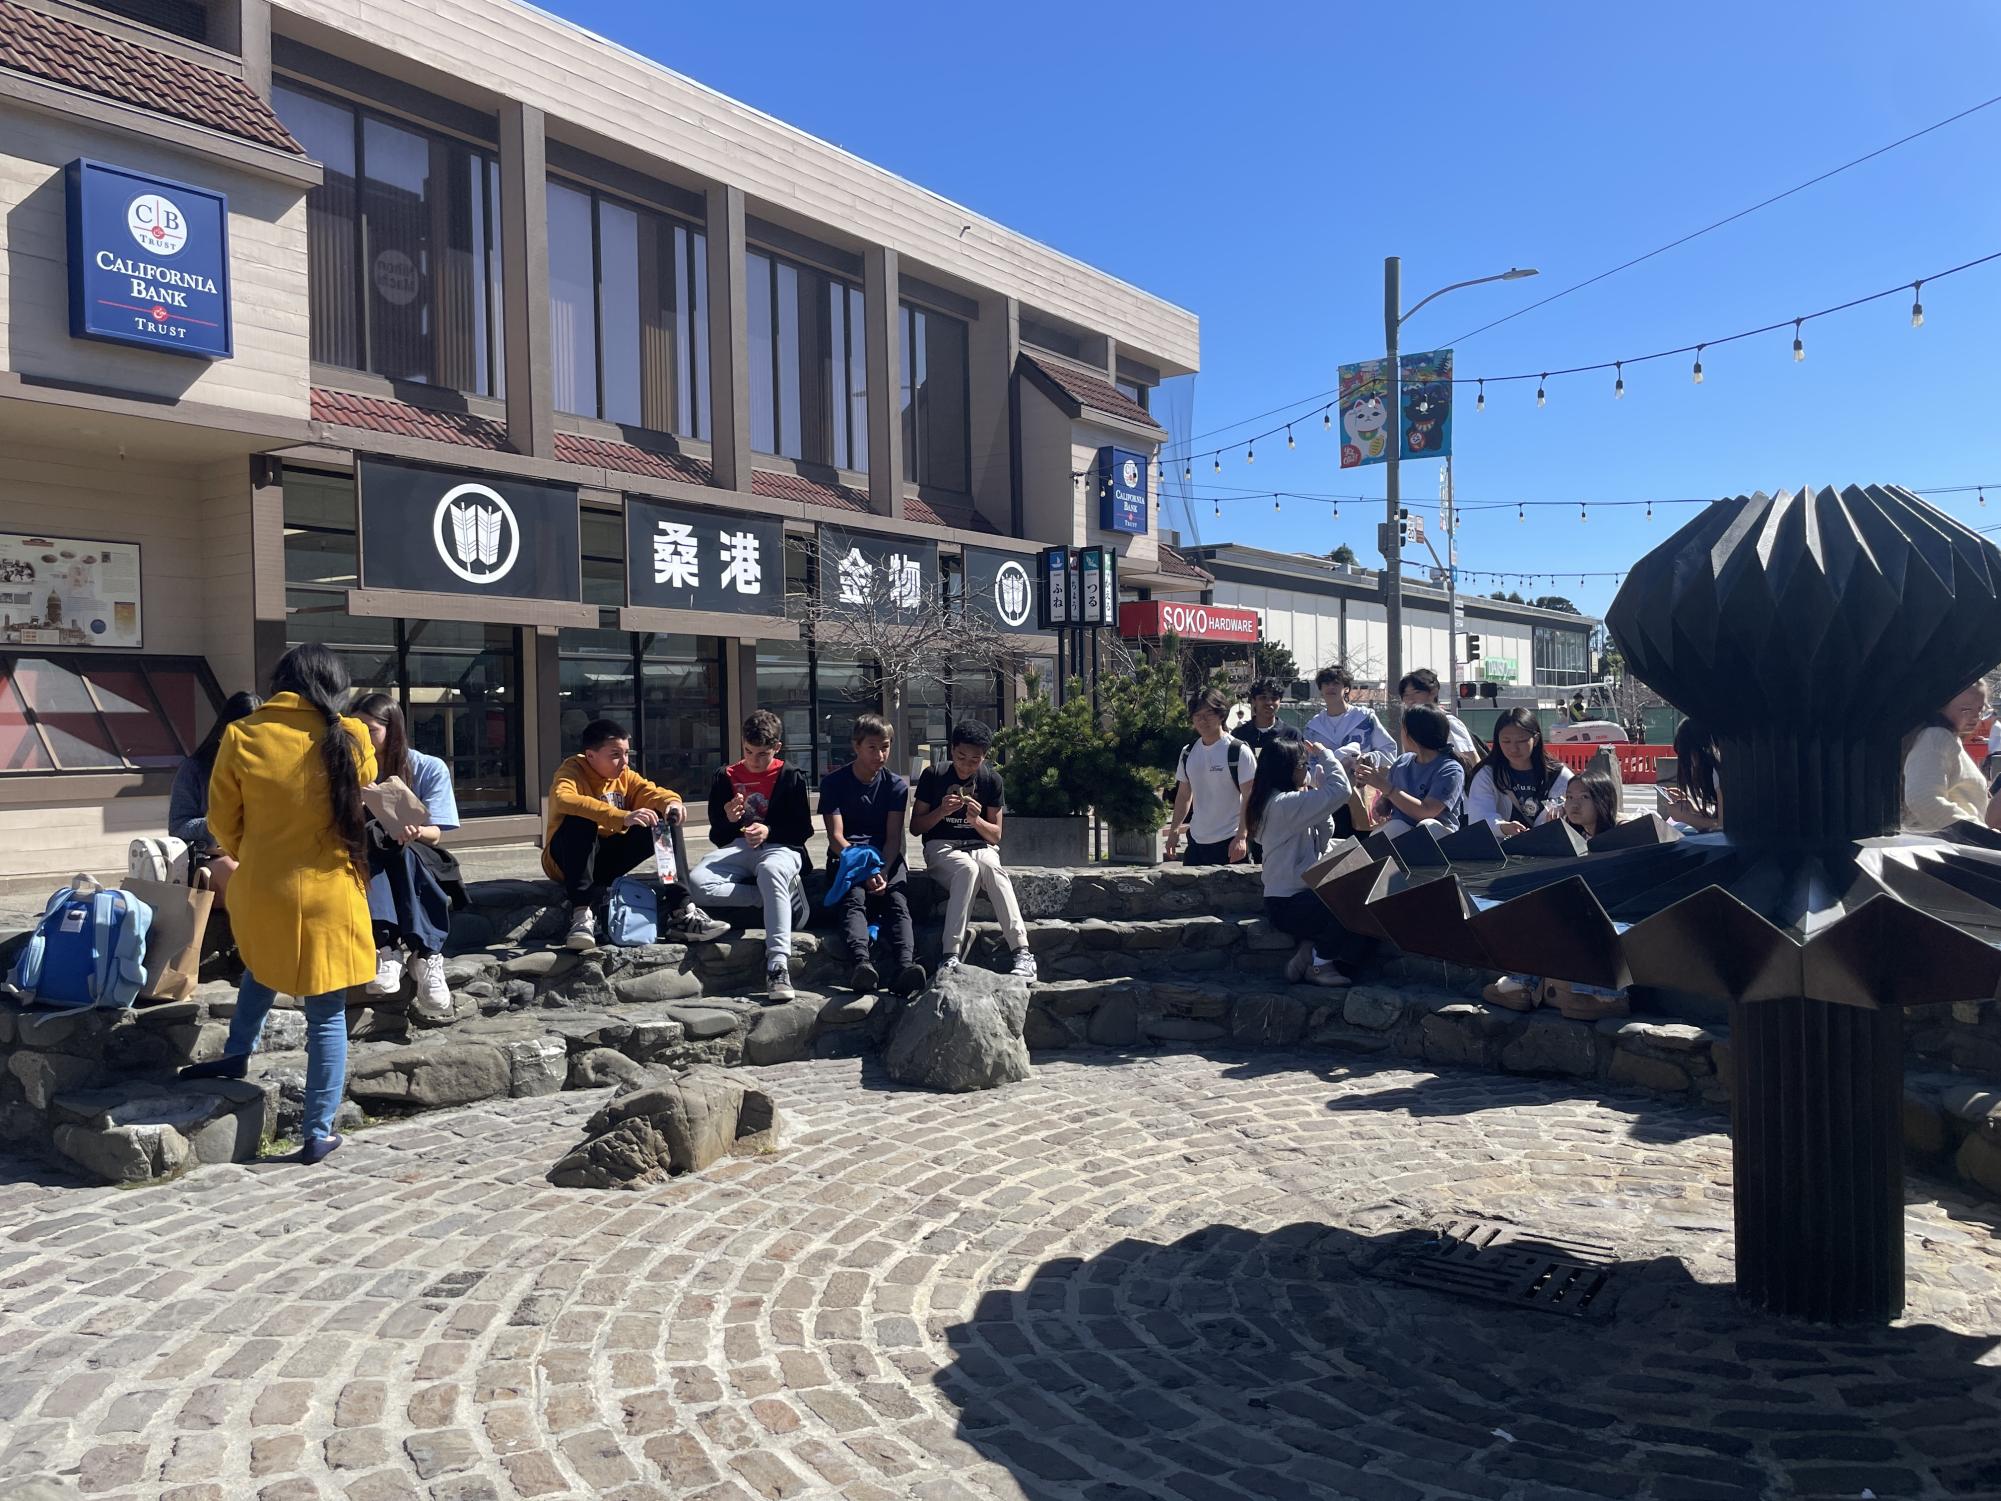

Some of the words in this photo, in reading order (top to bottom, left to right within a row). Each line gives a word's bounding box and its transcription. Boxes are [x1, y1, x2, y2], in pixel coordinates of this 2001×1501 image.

[140, 233, 177, 250] TRUST
[96, 250, 218, 294] CALIFORNIA
[130, 278, 188, 308] BANK
[135, 317, 187, 338] TRUST
[1115, 489, 1145, 505] CALIFORNIA
[1123, 502, 1138, 513] BANK
[653, 520, 761, 595] 桑港
[838, 547, 921, 608] 金物
[1052, 583, 1064, 609] ふね
[1087, 583, 1098, 608] つる
[1163, 606, 1207, 633] SOKO
[1208, 616, 1253, 633] HARDWARE
